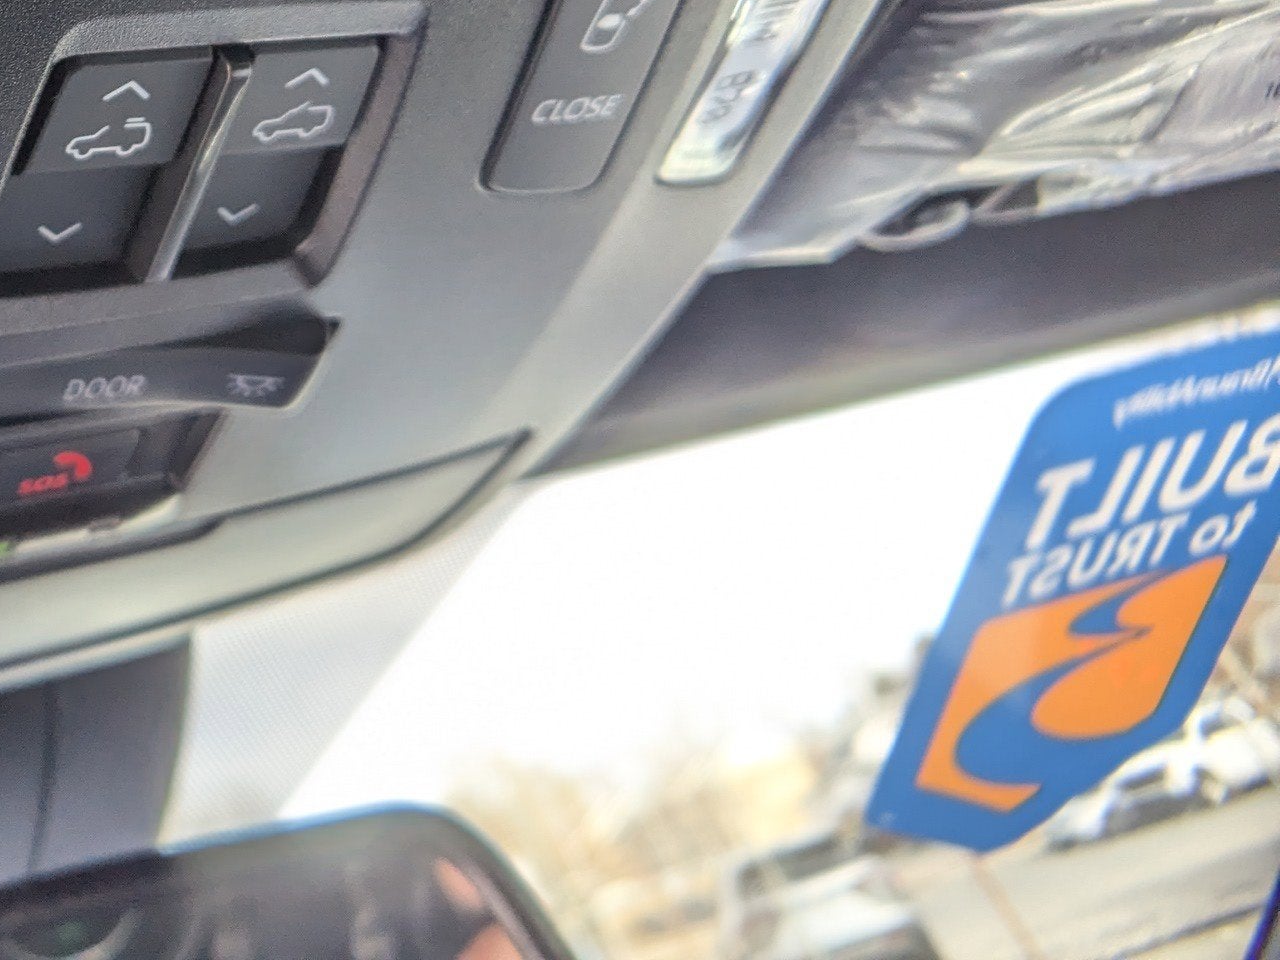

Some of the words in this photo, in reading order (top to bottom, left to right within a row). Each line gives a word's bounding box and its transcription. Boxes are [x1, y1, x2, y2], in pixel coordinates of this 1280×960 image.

[531, 94, 622, 126] CLOSE
[62, 373, 147, 403] DOOR
[17, 472, 68, 495] SOS
